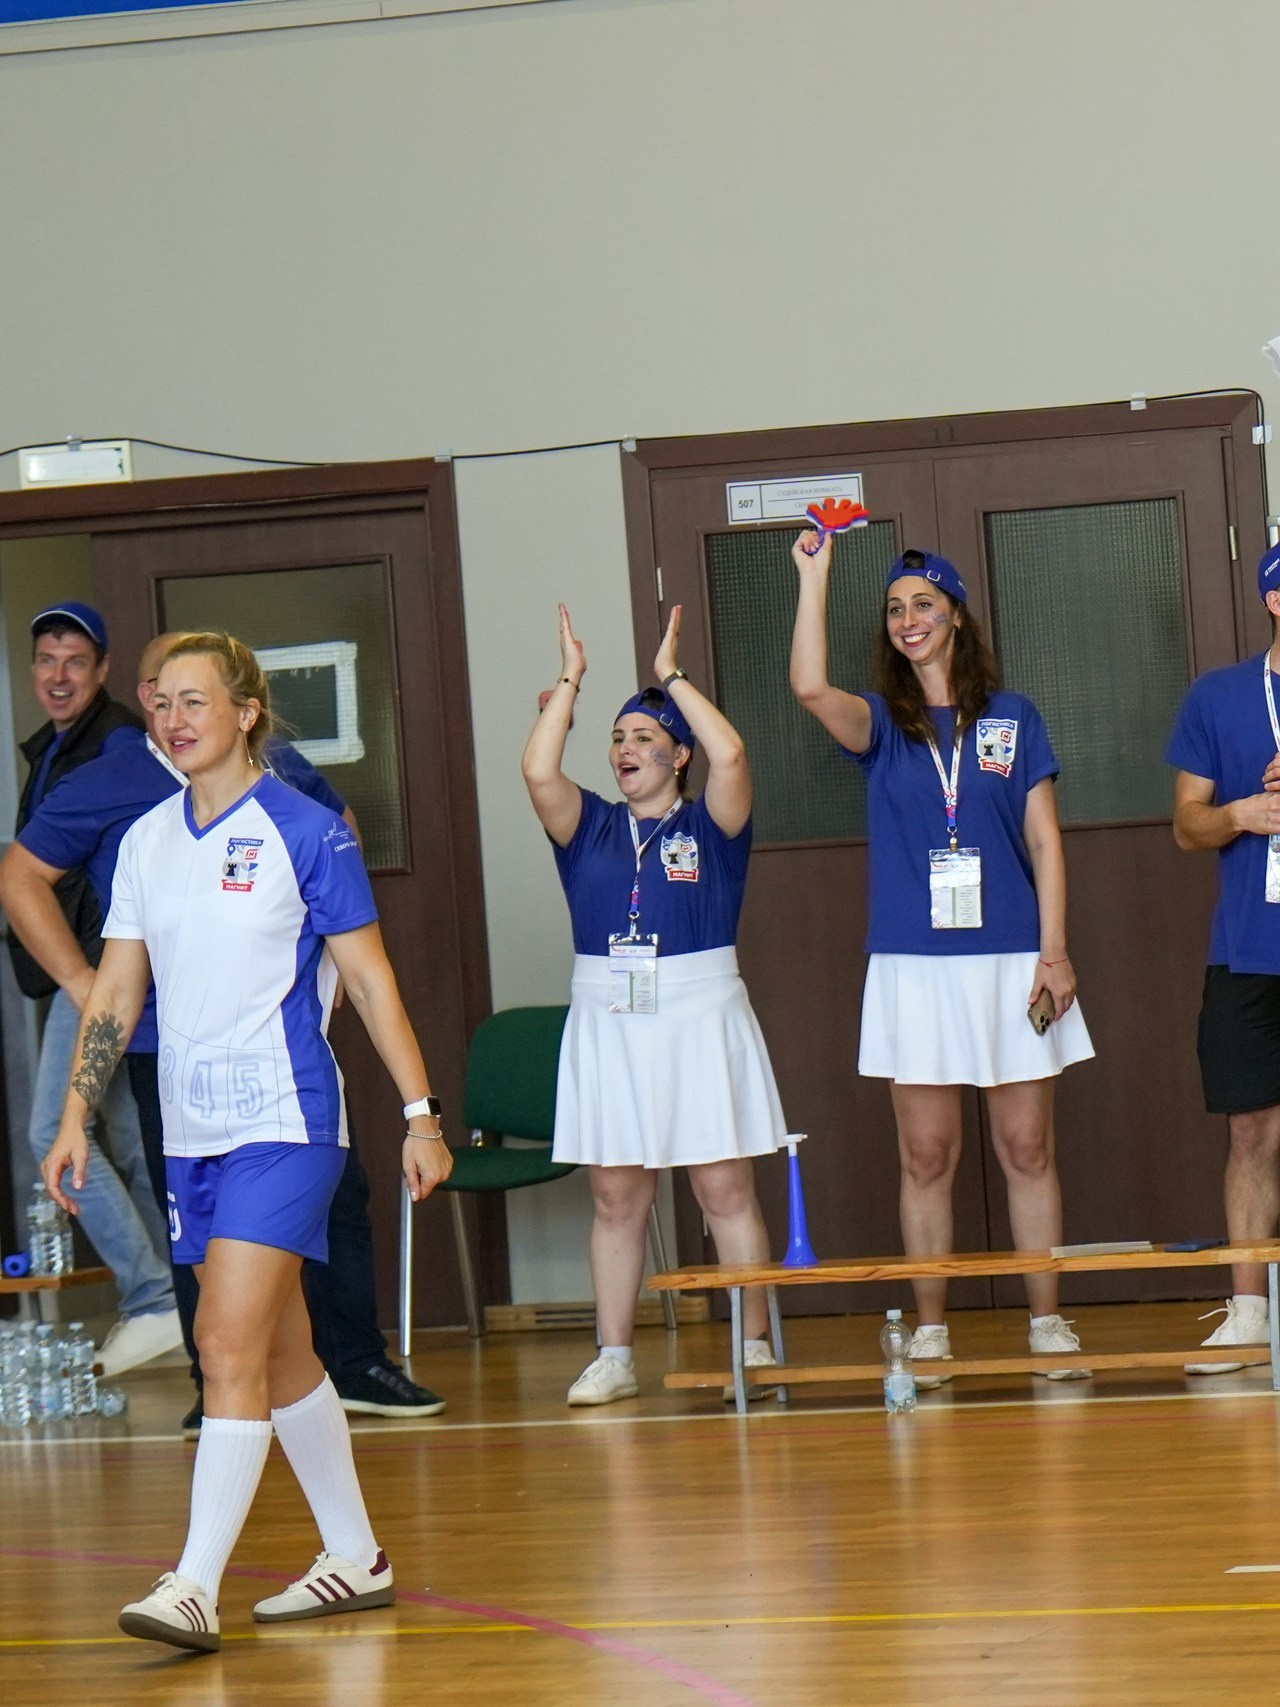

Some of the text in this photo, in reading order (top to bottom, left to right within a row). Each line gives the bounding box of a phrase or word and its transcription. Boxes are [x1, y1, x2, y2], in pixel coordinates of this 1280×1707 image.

[738, 499, 754, 508] 507
[980, 721, 1015, 729] ЛОГИСТИКА
[189, 1060, 216, 1120] 4
[232, 1062, 264, 1121] 5
